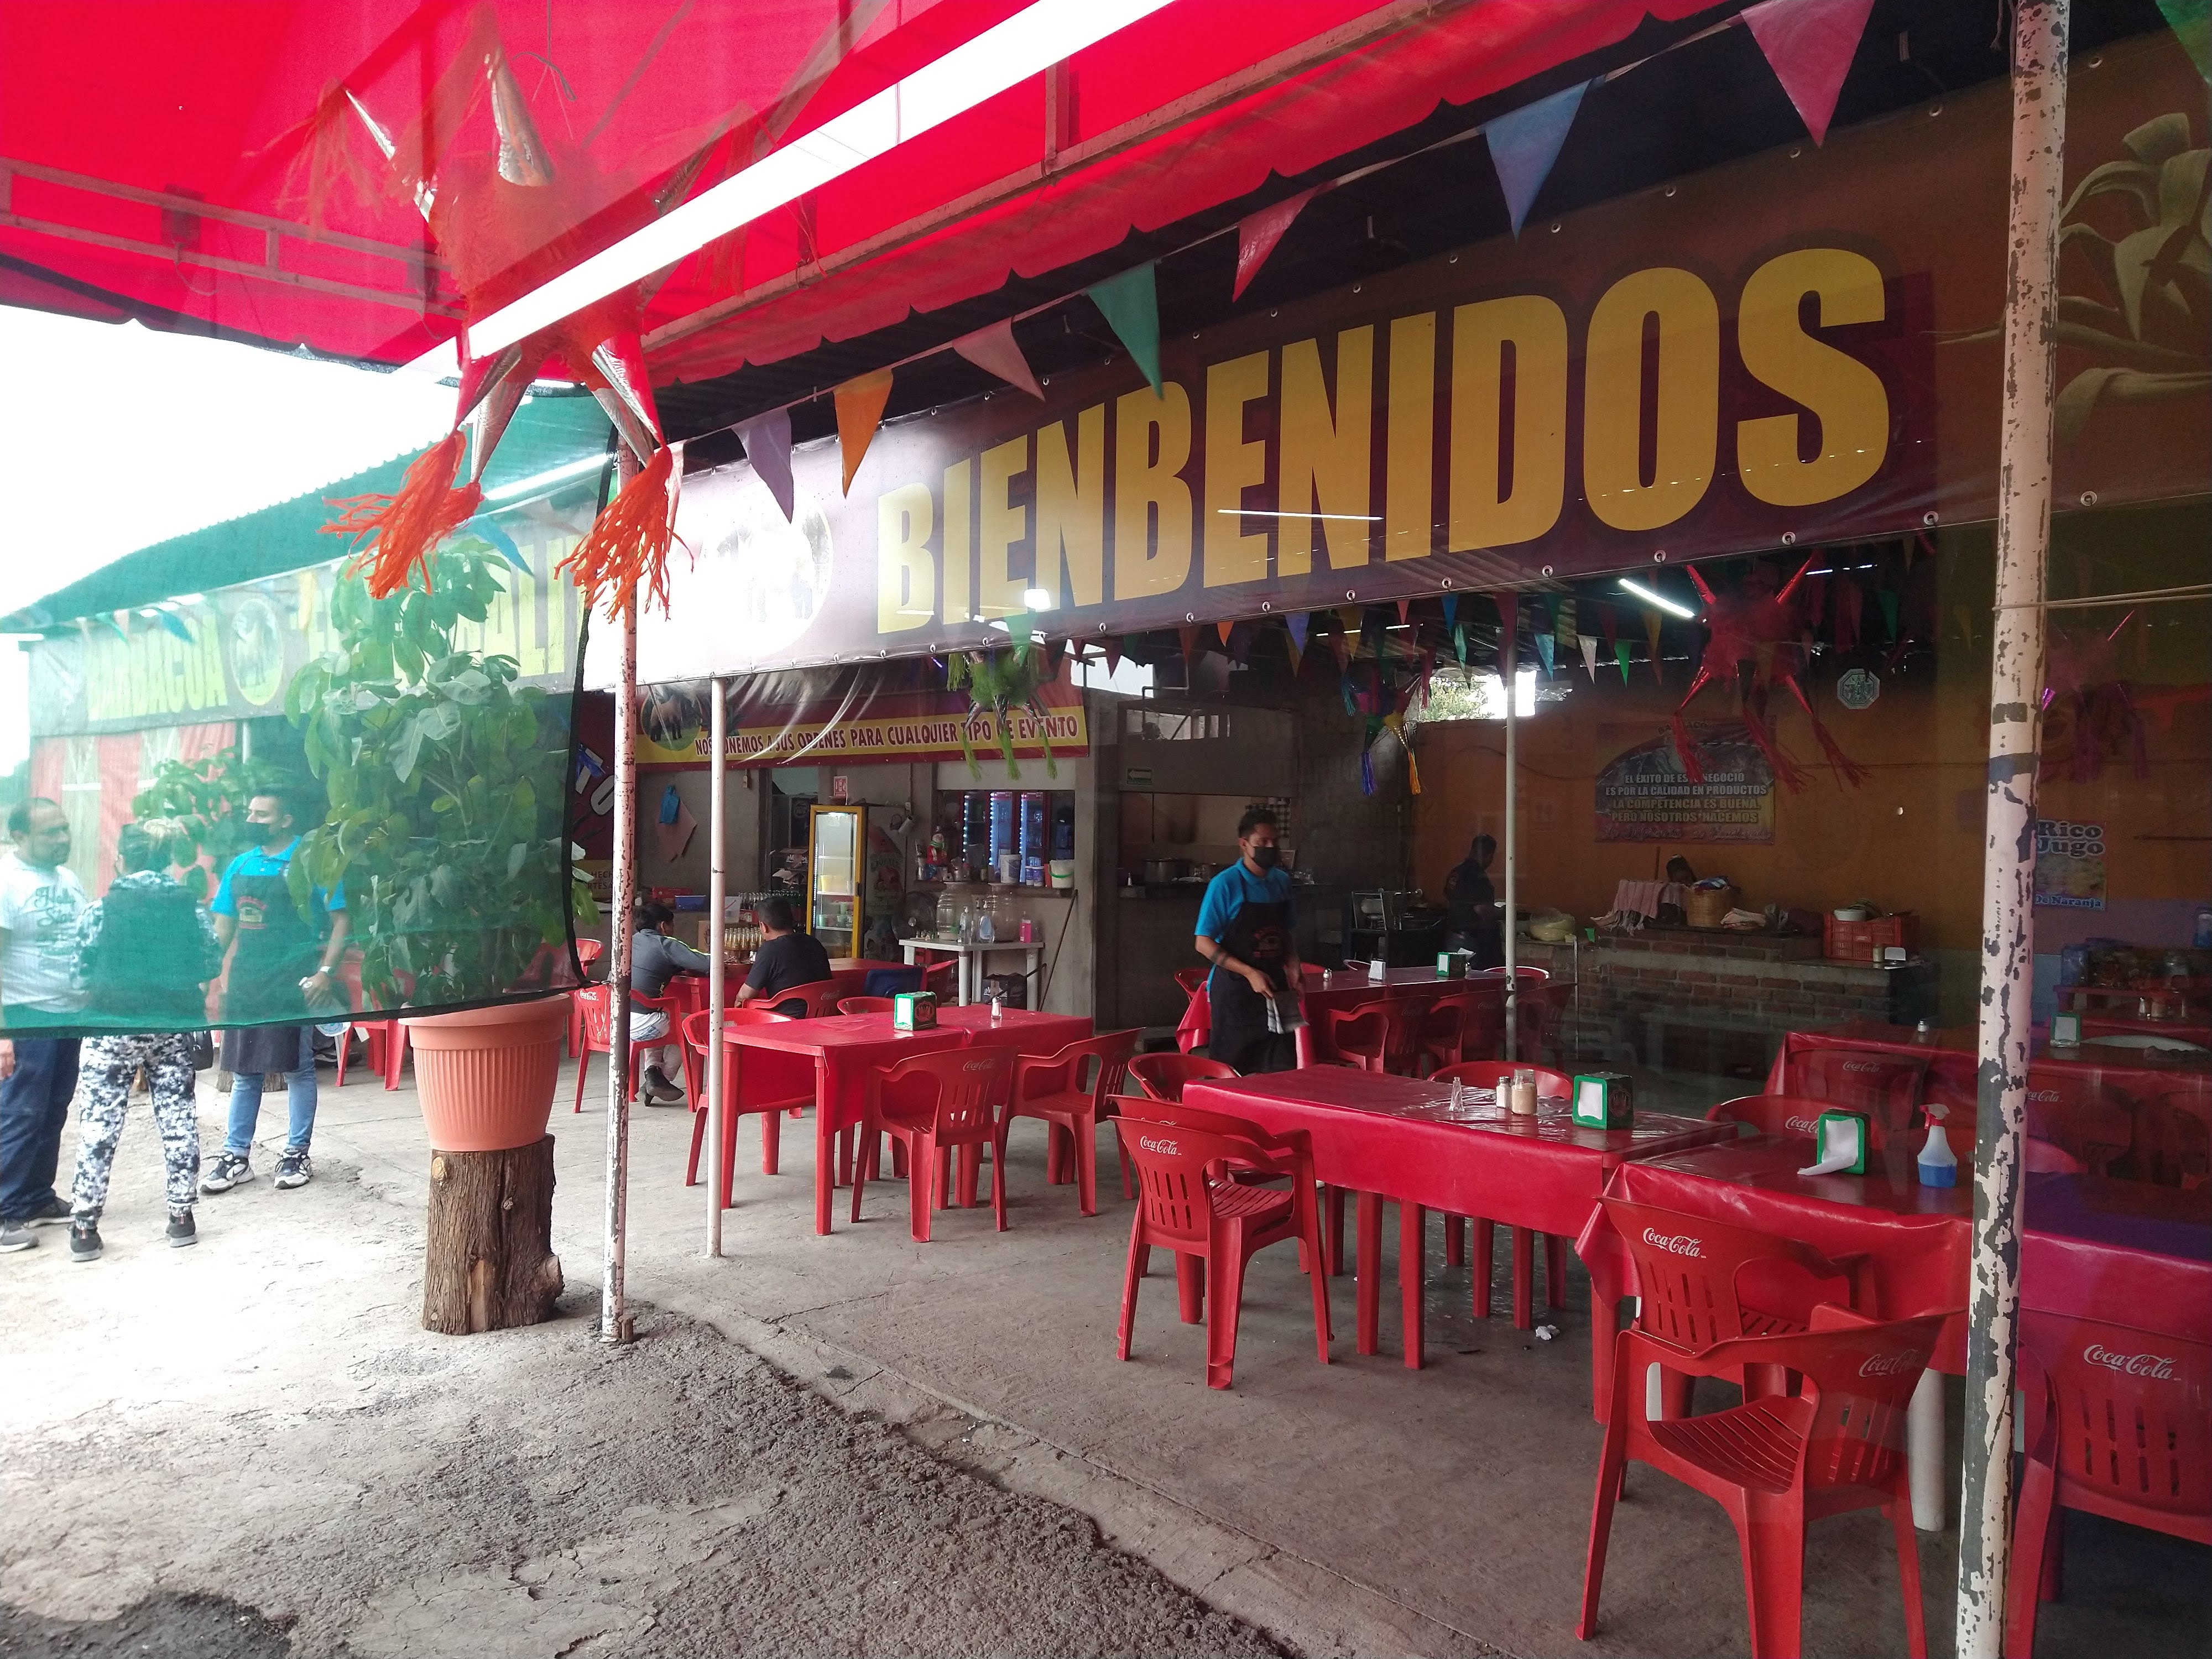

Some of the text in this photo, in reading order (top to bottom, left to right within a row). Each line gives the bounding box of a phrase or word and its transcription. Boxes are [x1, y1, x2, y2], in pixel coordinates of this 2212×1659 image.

[877, 248, 1890, 634] BIENBENIDOS
[725, 735, 763, 754] ONEMOS
[775, 733, 795, 752] SUS
[850, 728, 884, 747] PARA
[888, 722, 957, 745] CUALQUIER
[1625, 775, 1634, 783] EL
[1663, 774, 1675, 782] DE
[1606, 785, 1767, 796] ES POR LA CALIDAD EN PRODUCTOS
[1613, 800, 1624, 809] LA
[1627, 799, 1702, 809] COMPETENCIA
[1704, 799, 1717, 808] ES
[1640, 812, 1699, 822] NOSOTROS
[2038, 820, 2103, 839] Rico
[2037, 836, 2105, 859] Jugo
[2052, 895, 2101, 909] Naranja
[2027, 1090, 2060, 1102] ca-Cola
[1786, 1116, 1818, 1134] Coca-C
